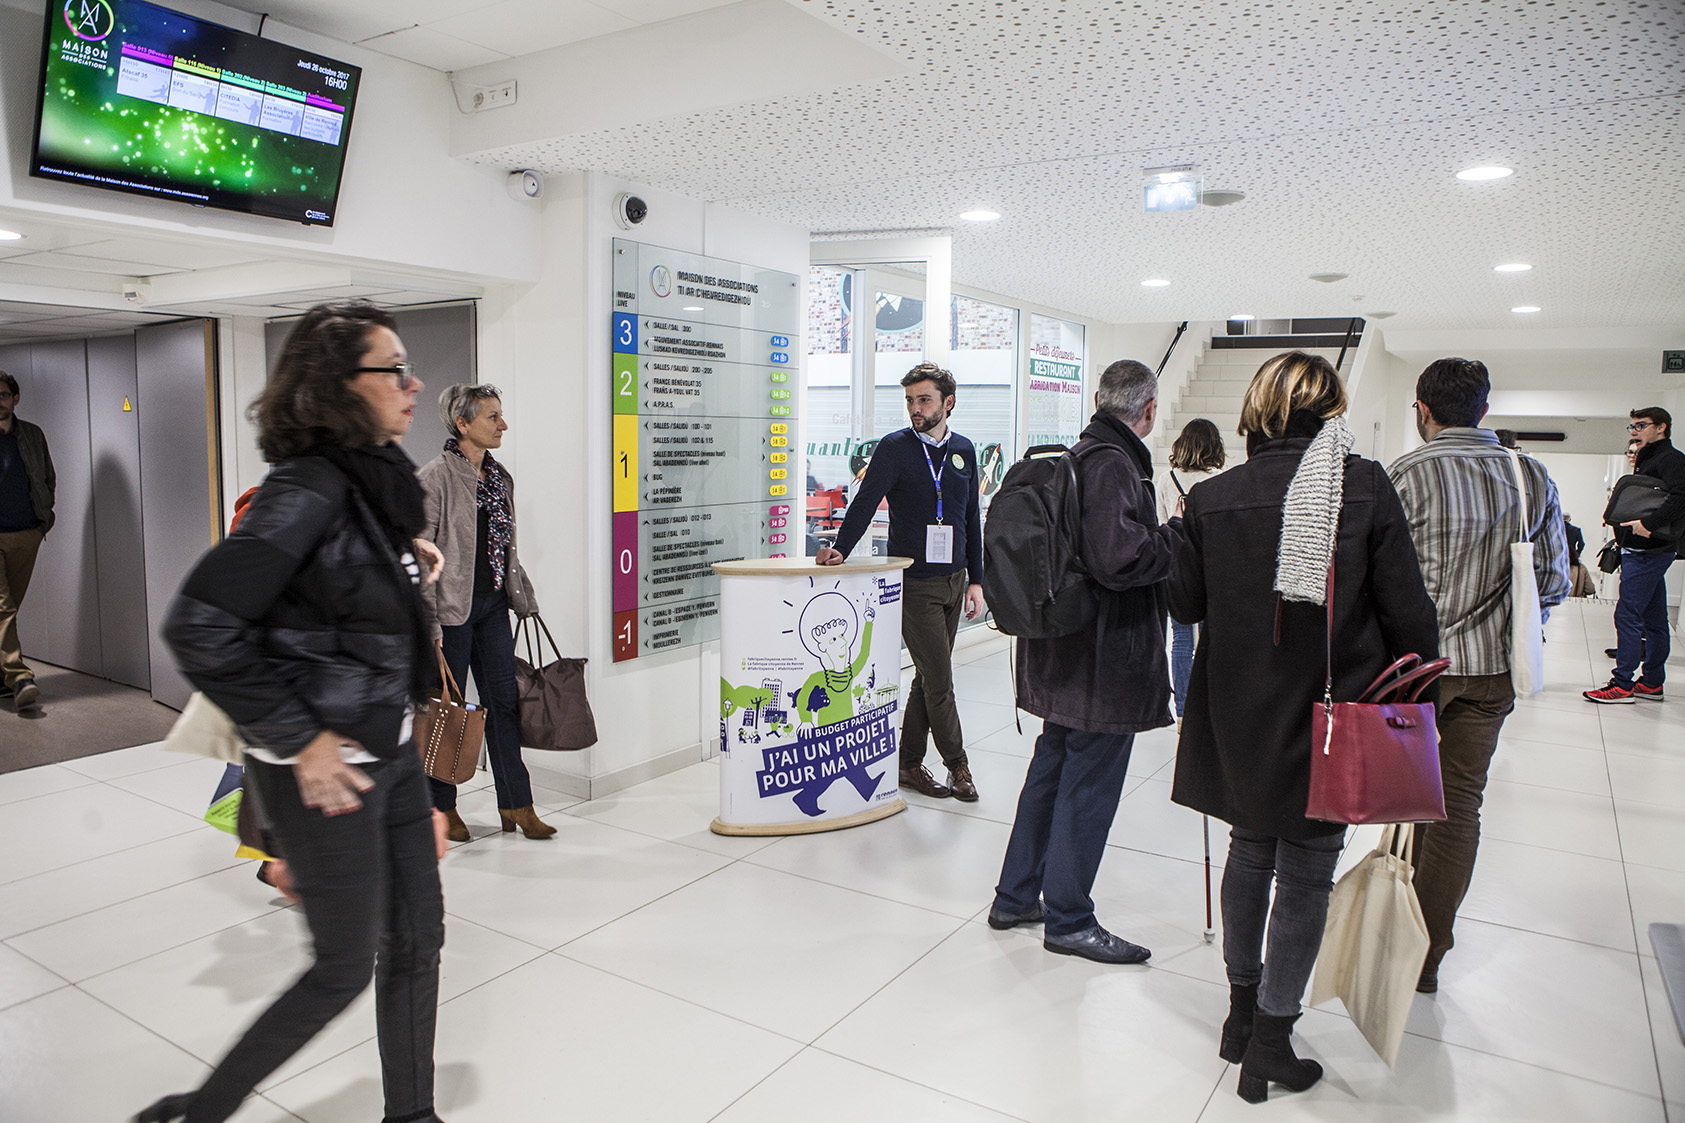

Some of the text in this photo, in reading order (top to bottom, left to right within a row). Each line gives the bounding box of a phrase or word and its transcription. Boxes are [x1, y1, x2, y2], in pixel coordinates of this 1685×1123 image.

[60, 54, 107, 70] ASSOCIATIONS
[297, 60, 350, 80] Jeudi 26 octobre 2017
[324, 76, 348, 90] 16H00
[677, 271, 759, 294] MAISON DES ASSOCIATIONS
[616, 290, 636, 300] NIVEAU
[677, 285, 685, 295] TI
[685, 287, 695, 297] AR
[617, 300, 628, 308] LIVE
[619, 319, 632, 346] 3
[653, 321, 667, 330] SALLE
[670, 324, 680, 332] SAL
[653, 363, 670, 371] SALLES
[691, 366, 701, 374] 200
[1034, 360, 1076, 379] RESTAURANT
[620, 370, 633, 396] 2
[653, 377, 702, 388] FRANCE BÉNÉVOLAT 35
[1030, 379, 1081, 394] ABRICATION MAISON
[694, 389, 701, 397] 35
[653, 422, 670, 430] SALLES
[653, 436, 670, 444] SALLES
[806, 437, 872, 457] uantic
[653, 450, 667, 458] SALLE
[667, 450, 673, 458] DE
[673, 450, 700, 458] SPECTACLES
[620, 453, 628, 479] 1
[653, 459, 662, 467] SAL
[653, 473, 663, 481] BUG
[659, 486, 682, 495] PÉPINIÈRE
[653, 517, 669, 525] SALLES
[653, 531, 667, 539] SALLE
[653, 545, 667, 553] SALLE
[673, 541, 700, 550] SPECTACLES
[620, 549, 632, 575] 0
[653, 554, 662, 562] SAL
[653, 567, 670, 576] CENTRE
[671, 565, 677, 573] DE
[677, 563, 704, 572] RESSOURCES
[653, 587, 684, 599] GESTIONNAIRE
[653, 610, 667, 618] CANAL
[675, 605, 691, 614] ESPACE
[696, 601, 715, 610] PENVERN
[653, 619, 667, 627] CANAL
[699, 609, 718, 618] PENVERN
[618, 619, 632, 645] -1
[653, 629, 679, 640] IMPRIMERIE
[653, 637, 681, 649] MOULLEREZH
[815, 703, 895, 738] BUDGET PARTICIPATIF
[769, 717, 886, 773] J'AI UN PROJET
[762, 734, 894, 791] POUR MA VILLE !
